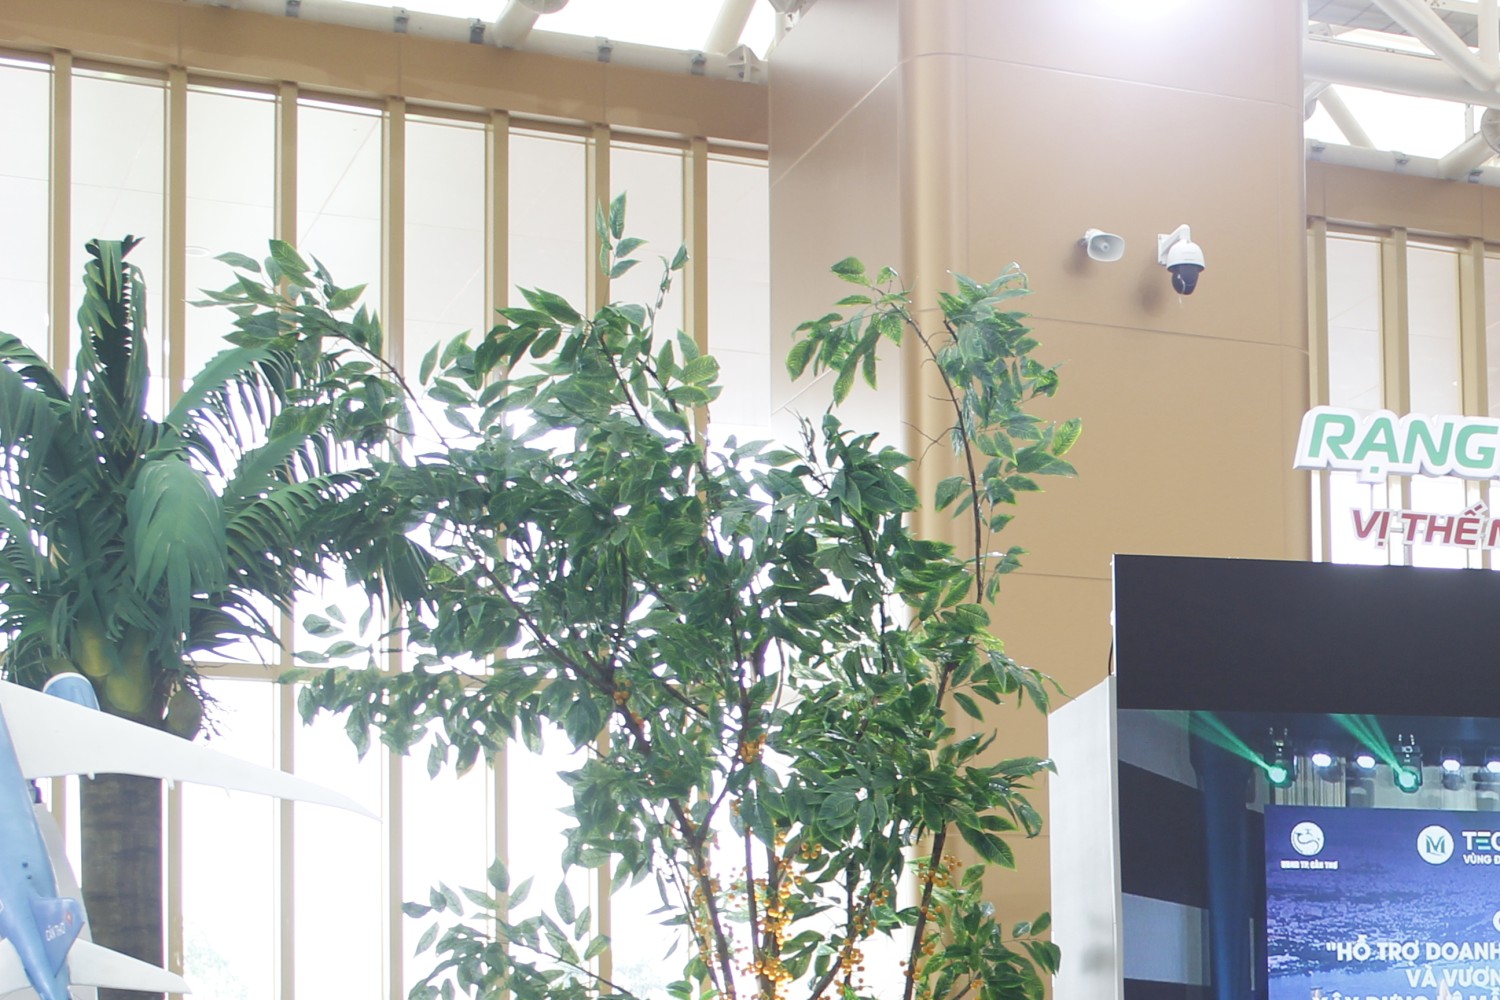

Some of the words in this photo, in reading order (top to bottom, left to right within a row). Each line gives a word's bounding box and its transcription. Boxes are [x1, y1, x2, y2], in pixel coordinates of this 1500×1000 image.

[1308, 412, 1500, 475] RẠNG
[1352, 510, 1391, 550] VỊ
[1399, 503, 1483, 545] THẾ
[1463, 852, 1491, 865] VÙNG
[1326, 934, 1371, 961] "HỖ
[1376, 941, 1420, 966] TRỢ
[1406, 964, 1437, 988] VÀ
